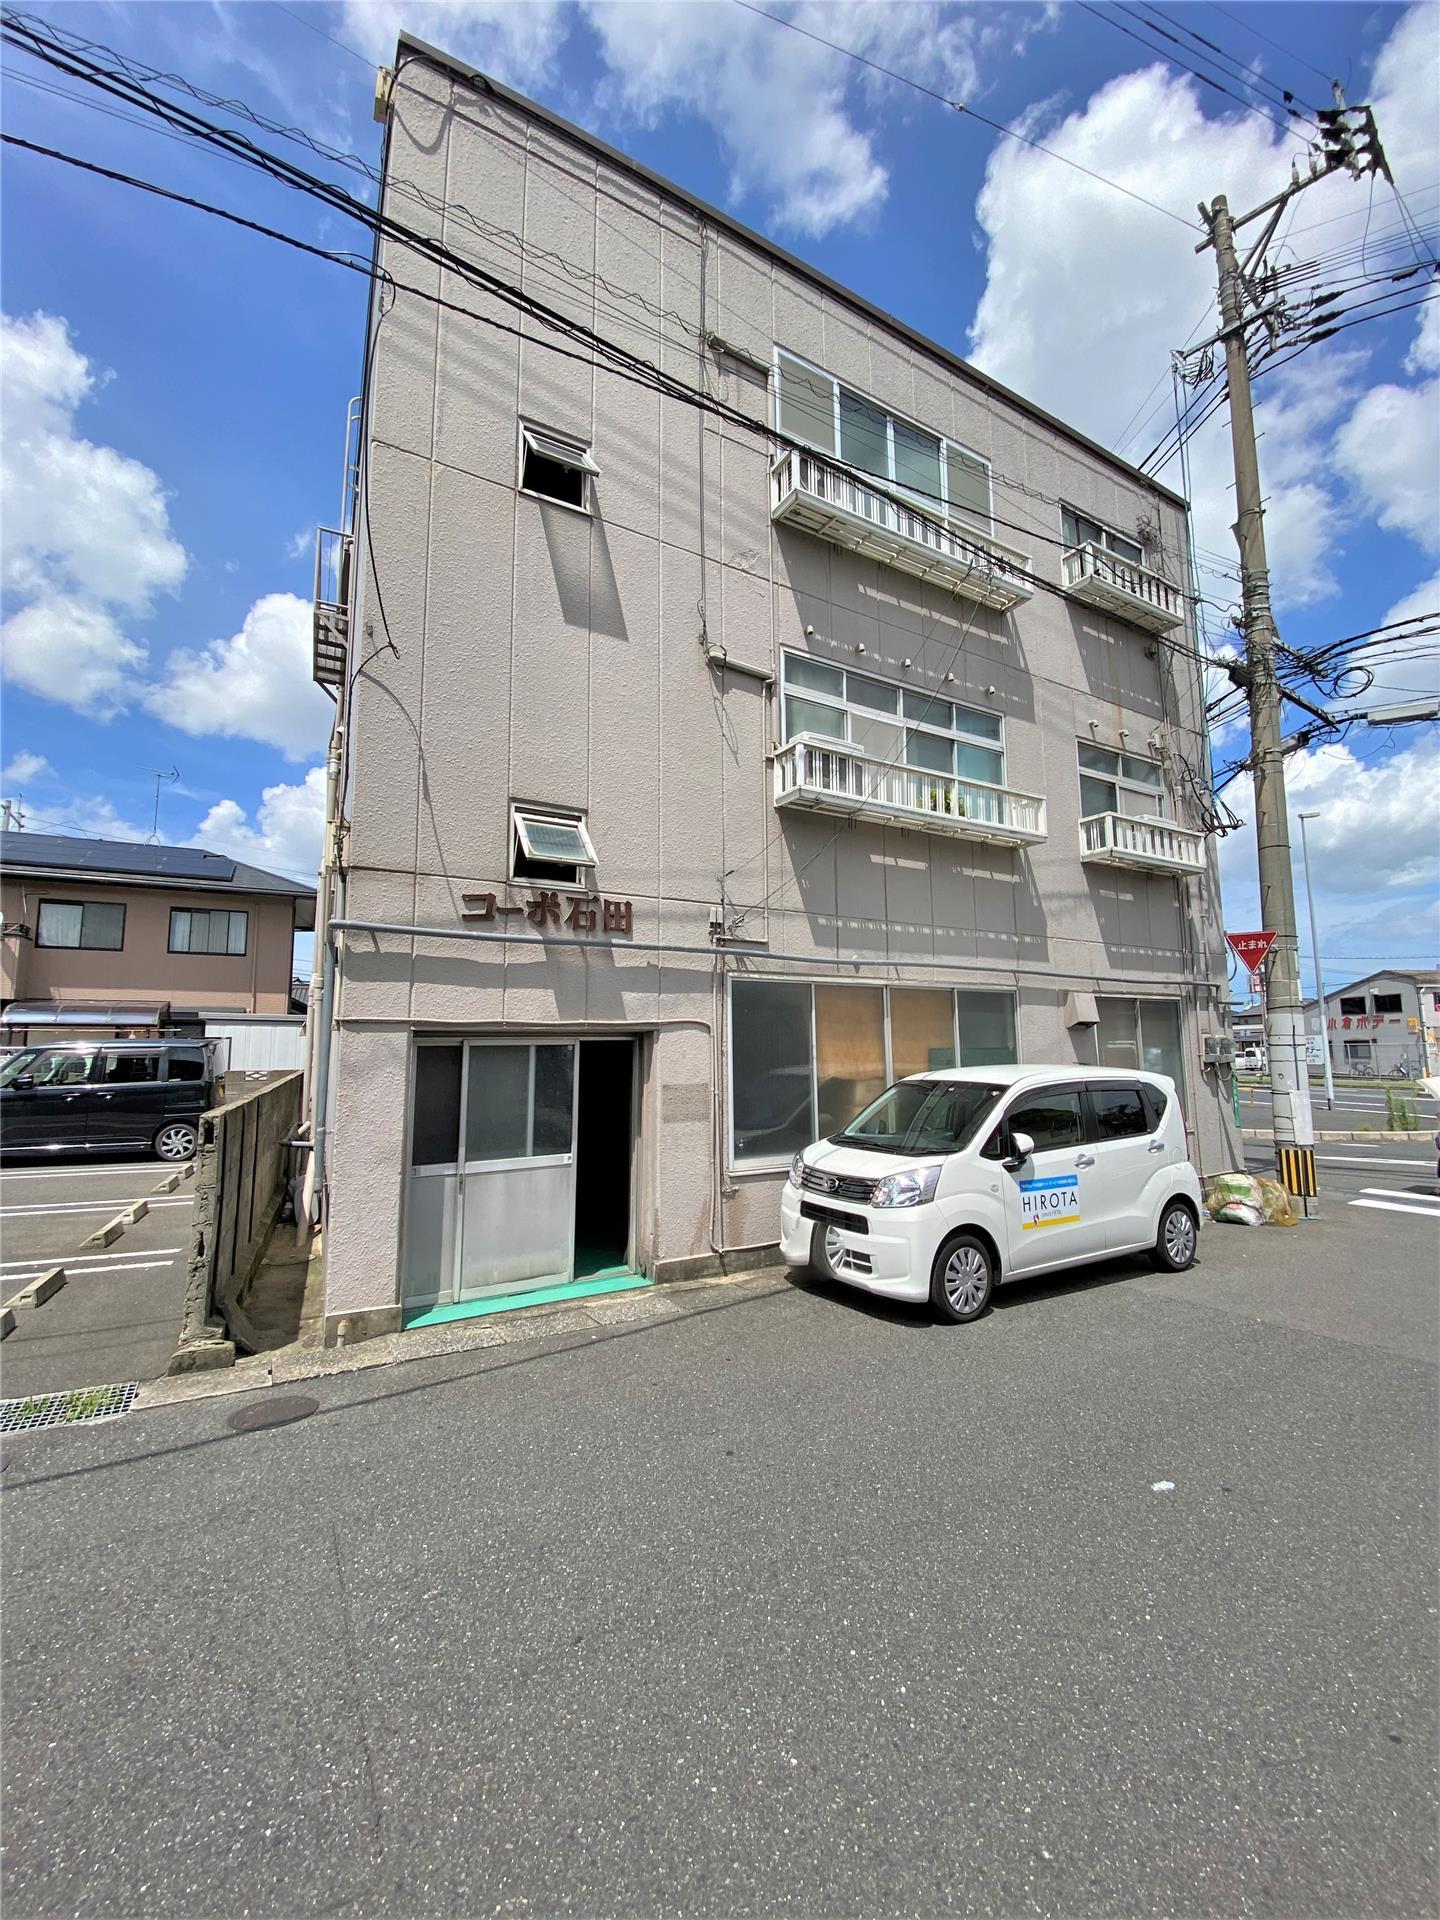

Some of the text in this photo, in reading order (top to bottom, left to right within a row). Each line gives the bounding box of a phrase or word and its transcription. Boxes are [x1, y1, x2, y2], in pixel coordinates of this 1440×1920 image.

[461, 891, 633, 933] コーポ石田
[1238, 939, 1267, 950] 止まれ
[1022, 1190, 1078, 1212] HIROTA
